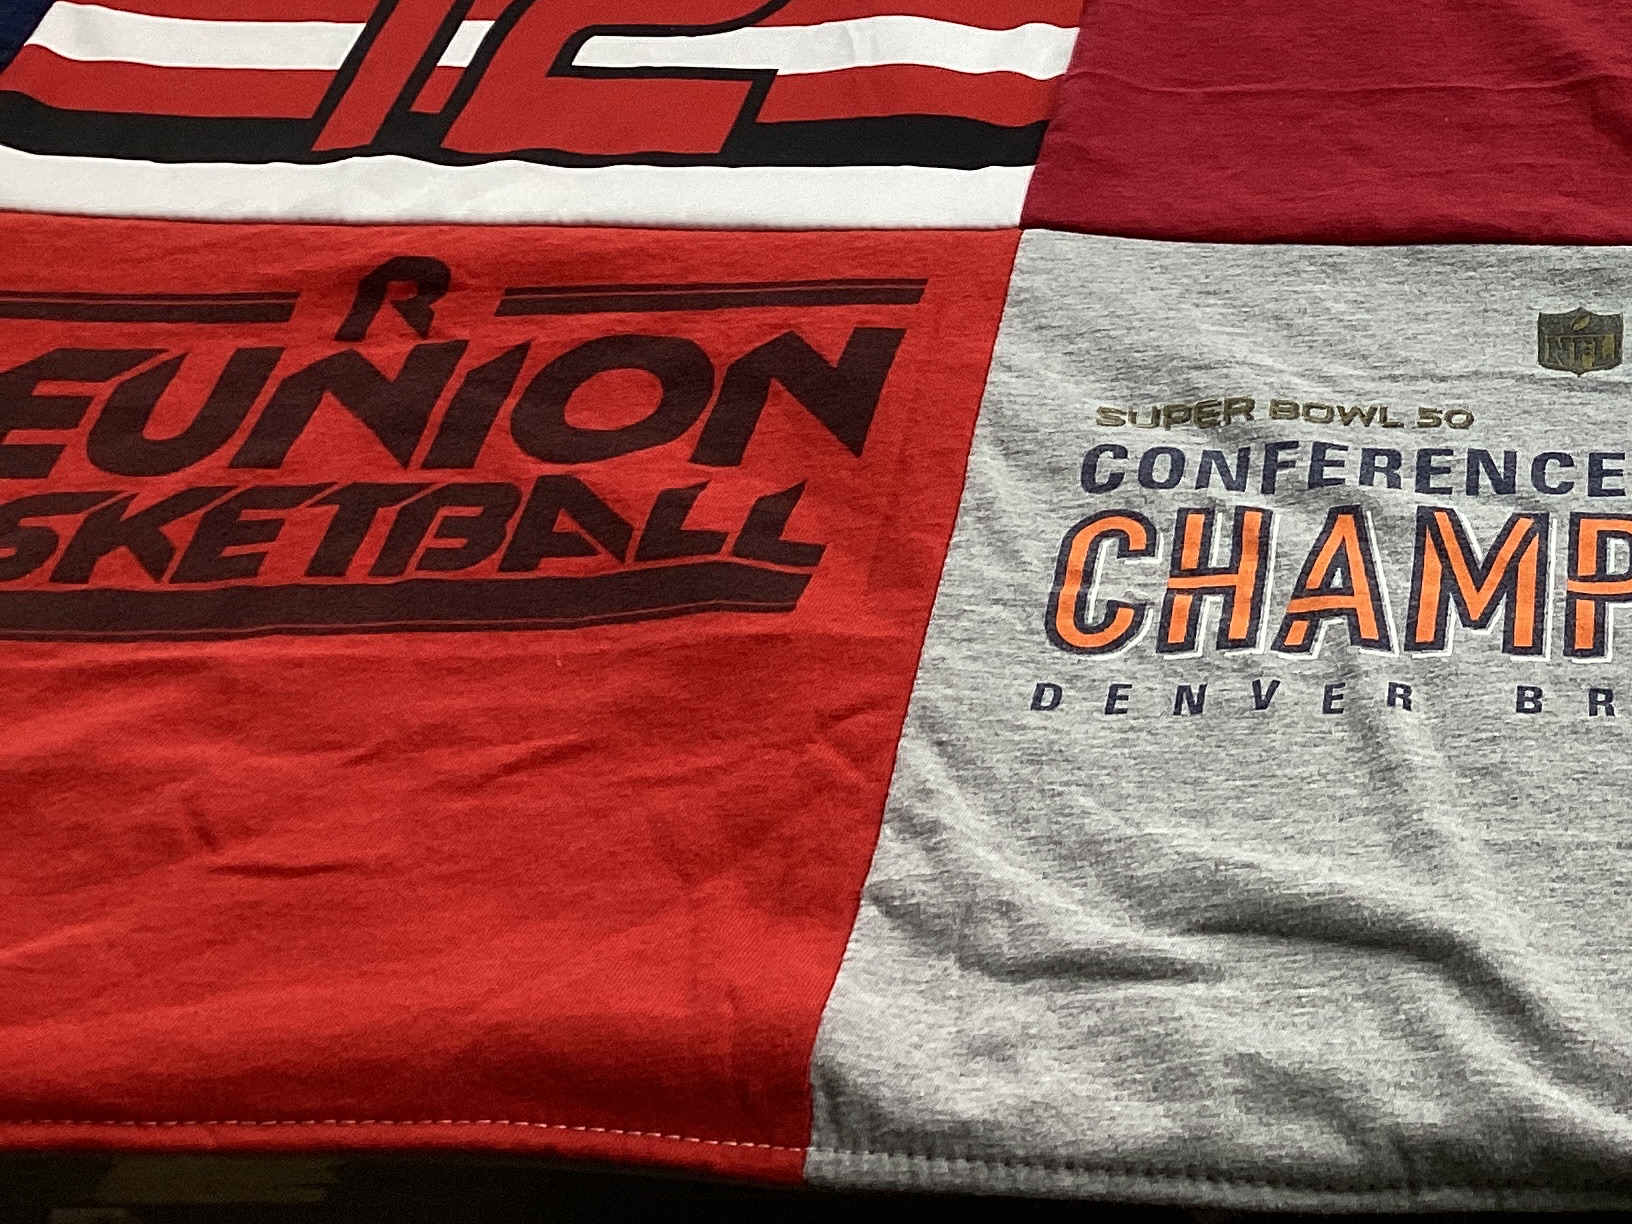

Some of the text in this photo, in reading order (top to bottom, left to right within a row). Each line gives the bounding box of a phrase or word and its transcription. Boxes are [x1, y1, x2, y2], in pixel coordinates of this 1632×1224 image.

[333, 255, 452, 342] R
[1096, 395, 1476, 430] SUPER BOWL 50
[1080, 440, 1627, 498] CONFERENCE
[1030, 678, 1415, 717] DENVER
